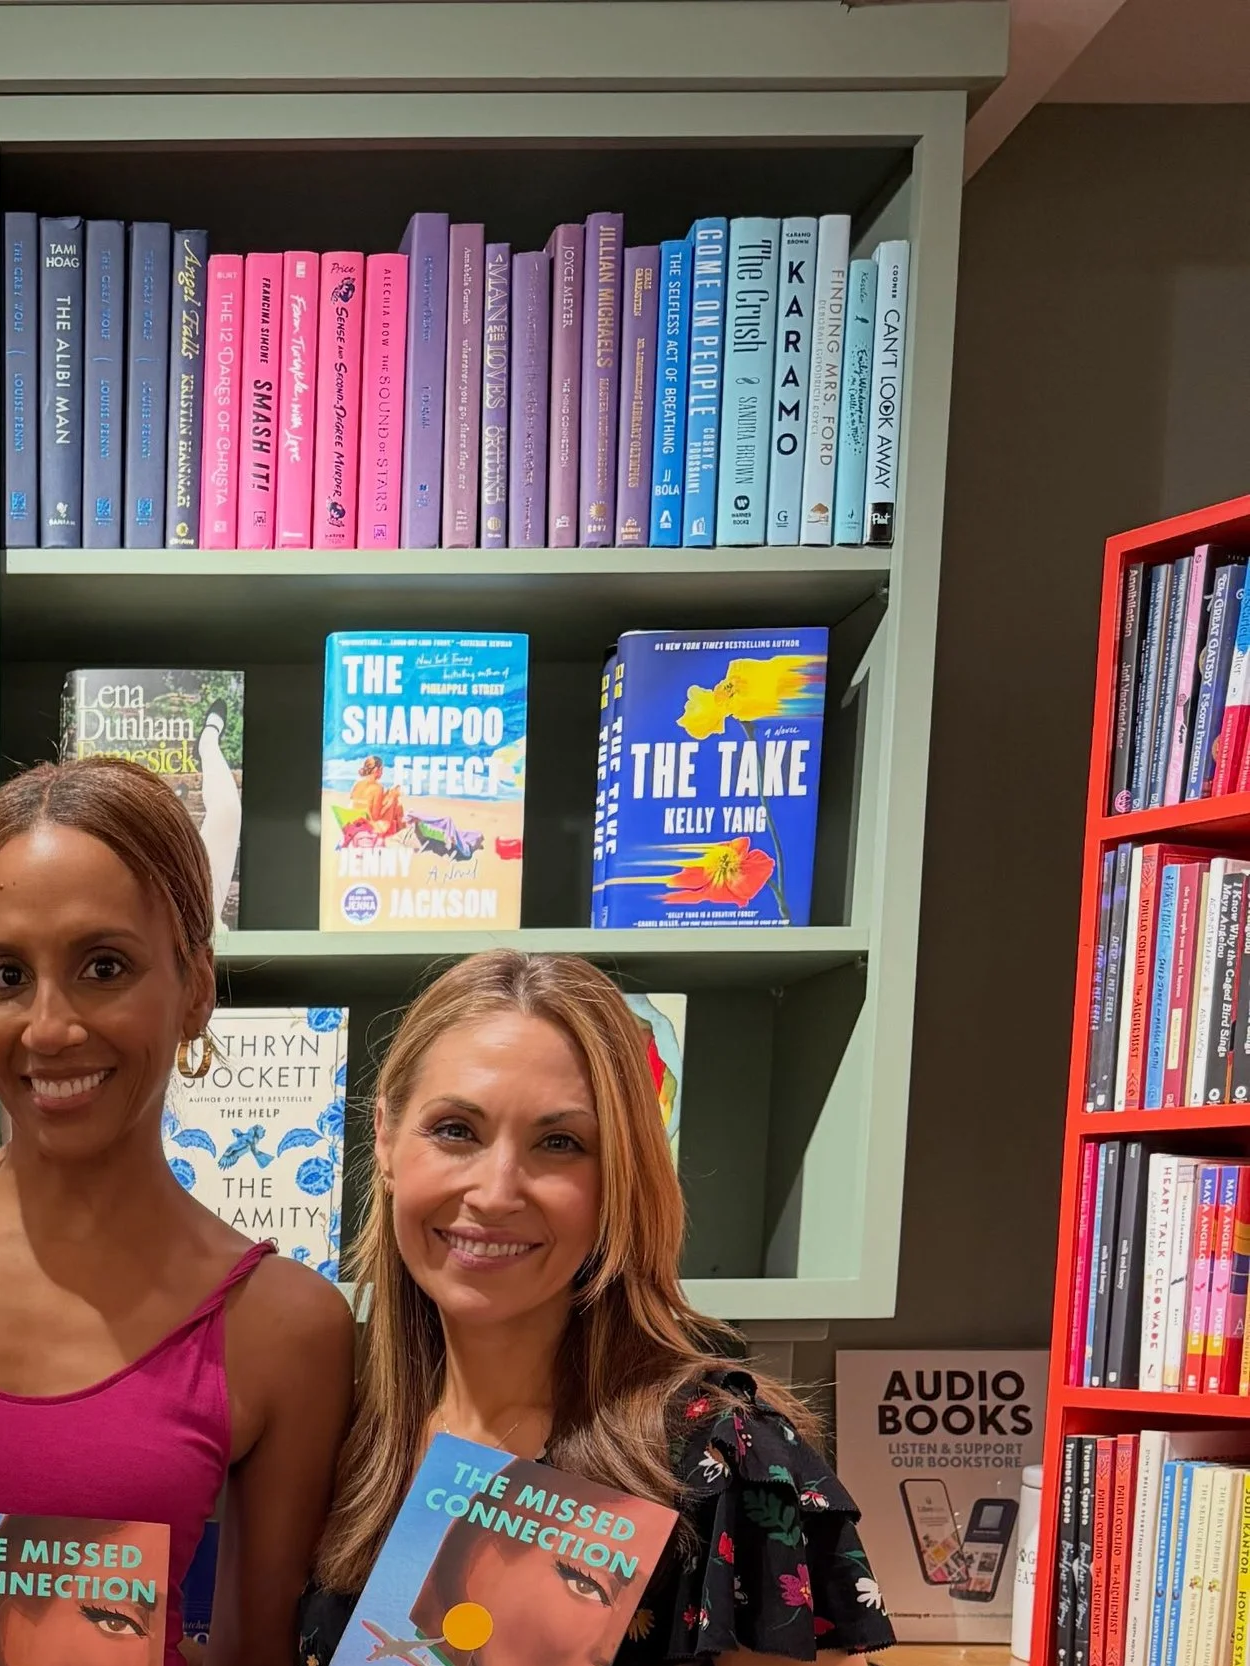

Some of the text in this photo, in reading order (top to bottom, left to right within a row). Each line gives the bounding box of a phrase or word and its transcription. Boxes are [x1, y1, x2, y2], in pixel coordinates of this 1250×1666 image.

[46, 257, 80, 268] HOAG
[50, 244, 76, 255] TAMI
[330, 263, 356, 274] Price
[599, 225, 616, 283] JILLIAN
[178, 239, 202, 360] Angel Falls
[562, 246, 575, 328] JOYCE MEYER
[891, 265, 899, 299] COONER
[596, 288, 614, 368] MICHAELS
[689, 229, 723, 416] COME ON PEOPLE
[882, 309, 900, 368] CAN'T
[56, 296, 71, 444] THE ALIBI MAN
[662, 253, 682, 455] THE SELFLESS ACT OF BREATHING
[733, 240, 773, 484] The Crush SANDRA BROWN
[776, 260, 806, 456] KARAMO
[819, 270, 845, 466] FINDING FORD
[252, 278, 273, 492] FRANCINA SIMONE SMASH IT!
[874, 435, 896, 489] AWAY
[655, 484, 680, 496] BOLA
[1124, 569, 1139, 638] Annihilation
[725, 639, 800, 649] BESTSELLING AUTHOR
[1202, 599, 1224, 687] GREAT GATSBY
[77, 677, 145, 708] Lena
[342, 655, 404, 695] THE
[420, 684, 505, 696] PINEAPPLE STREET
[77, 708, 196, 741] Dunham
[342, 705, 504, 745] SHAMPOO
[393, 756, 504, 795] EFFECT
[630, 740, 810, 799] THE TAKE
[663, 806, 767, 835] KELLY YANG
[338, 848, 414, 878] JENNY
[389, 889, 496, 918] JACKSON
[1221, 890, 1241, 1030] Know Why Bird
[220, 1109, 280, 1118] THE HELP
[1198, 1215, 1208, 1270] ANGELOU
[883, 1371, 1025, 1401] AUDIO
[878, 1404, 1033, 1436] BOOKS
[888, 1442, 1023, 1455] LISTEN & SUPPORT
[891, 1456, 1022, 1468] OUR BOOKSTORE
[454, 1462, 638, 1542] THE MISSED
[1063, 1443, 1074, 1524] Truman Capote
[1115, 1485, 1125, 1516] PAULO
[425, 1488, 639, 1578] CONNECTION
[20, 1540, 143, 1569] MISSED
